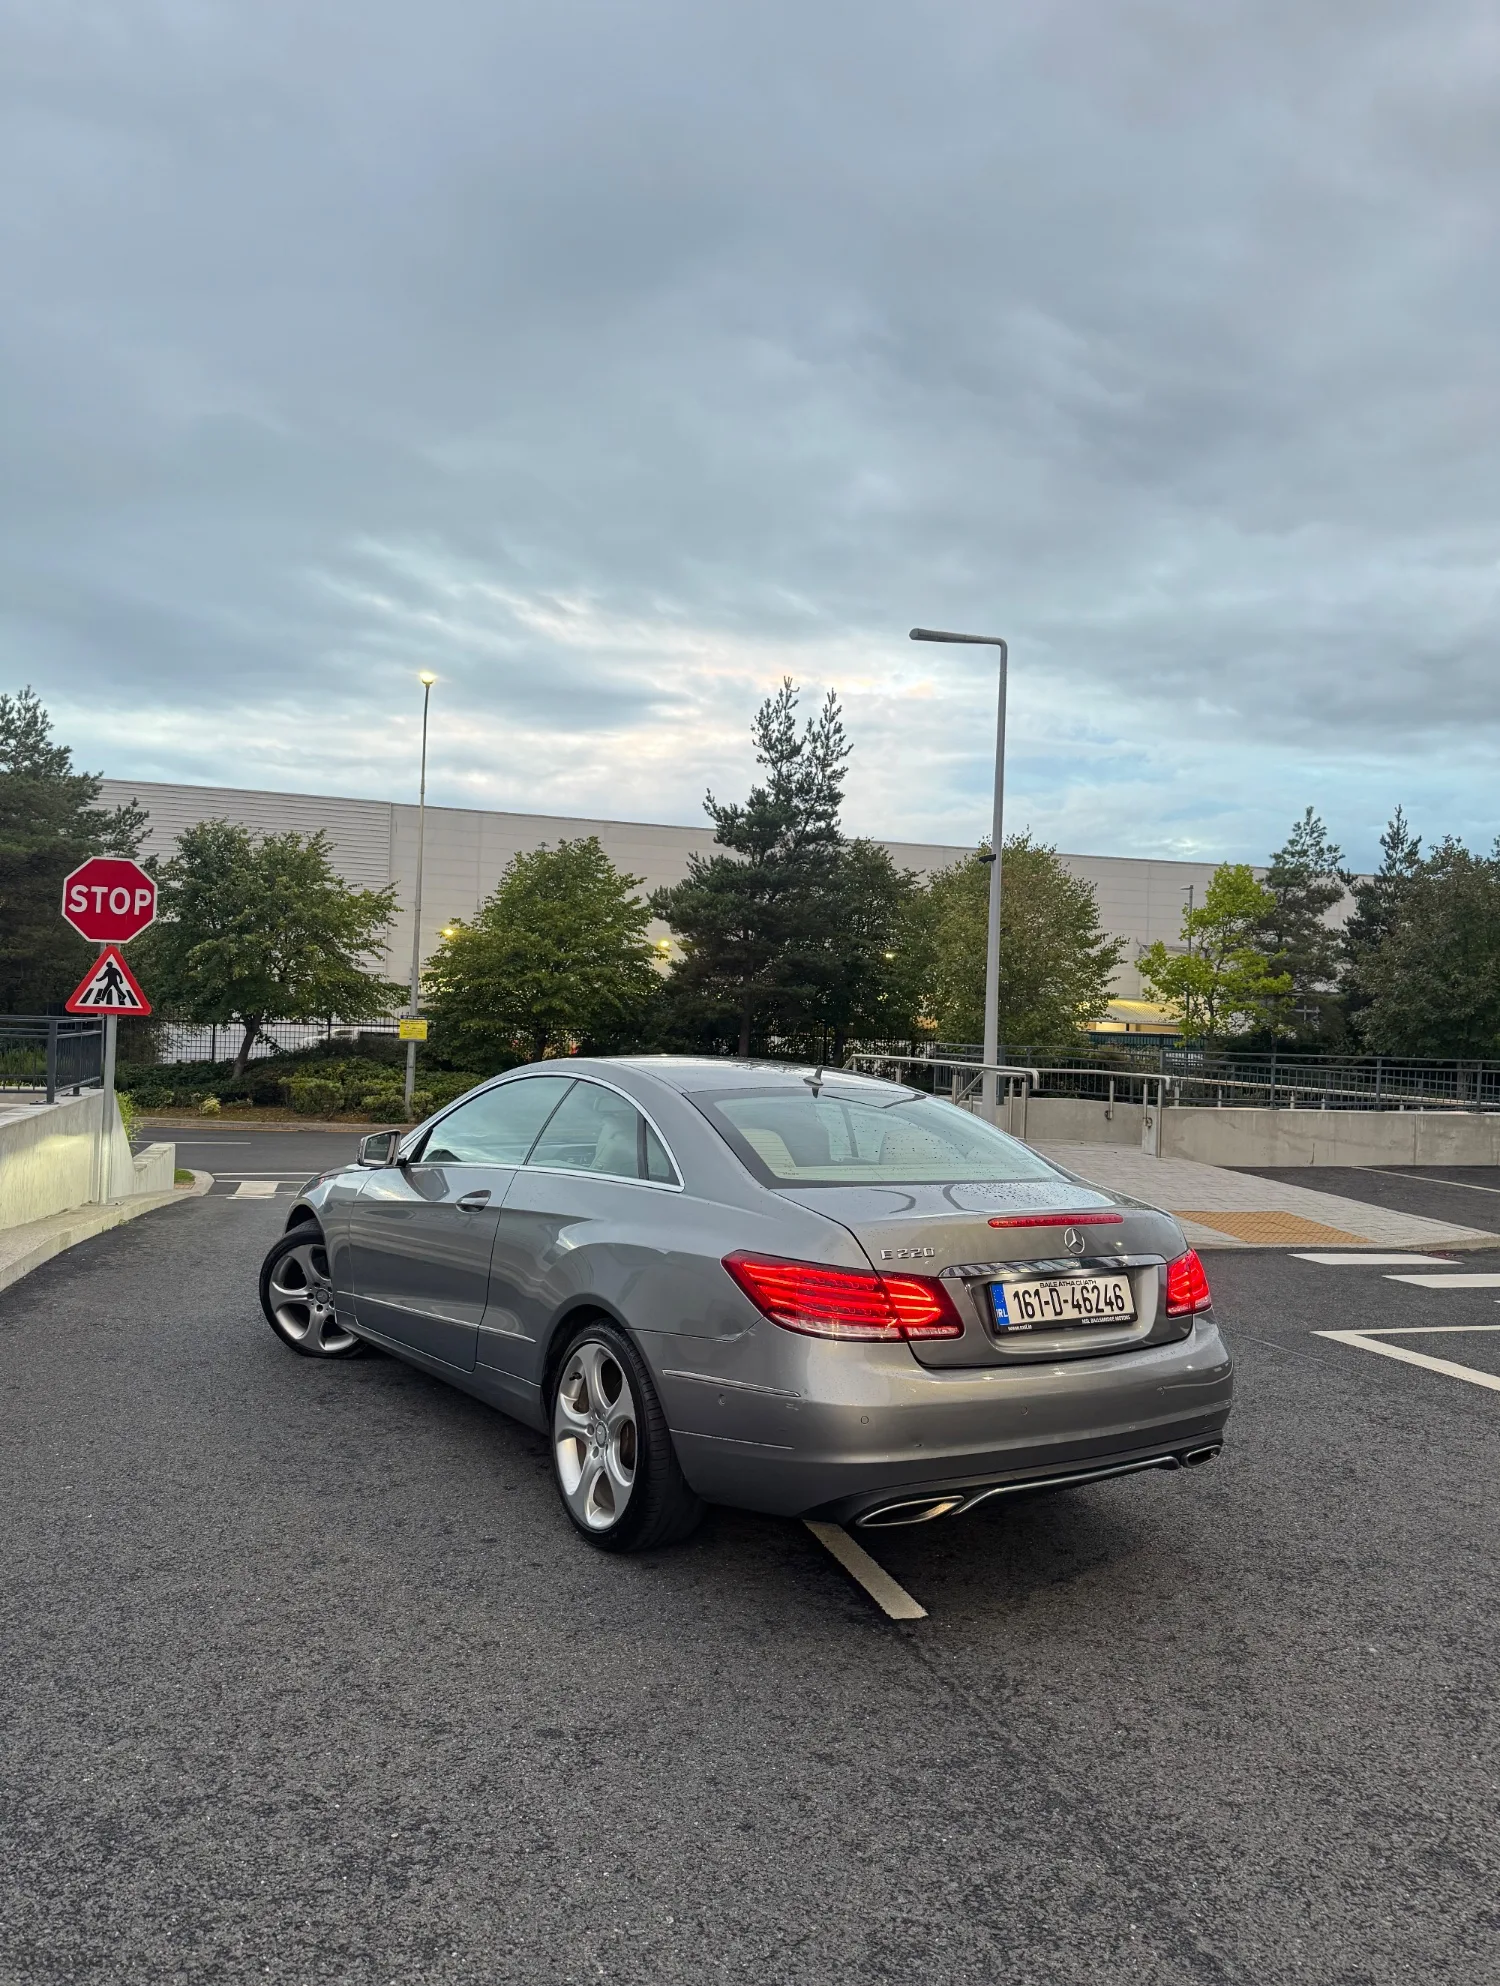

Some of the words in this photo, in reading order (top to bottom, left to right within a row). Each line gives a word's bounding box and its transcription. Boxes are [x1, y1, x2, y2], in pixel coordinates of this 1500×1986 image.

[68, 884, 152, 916] STOP
[881, 1249, 893, 1260] E
[897, 1247, 935, 1259] 220
[1013, 1284, 1125, 1319] 161-D-46246
